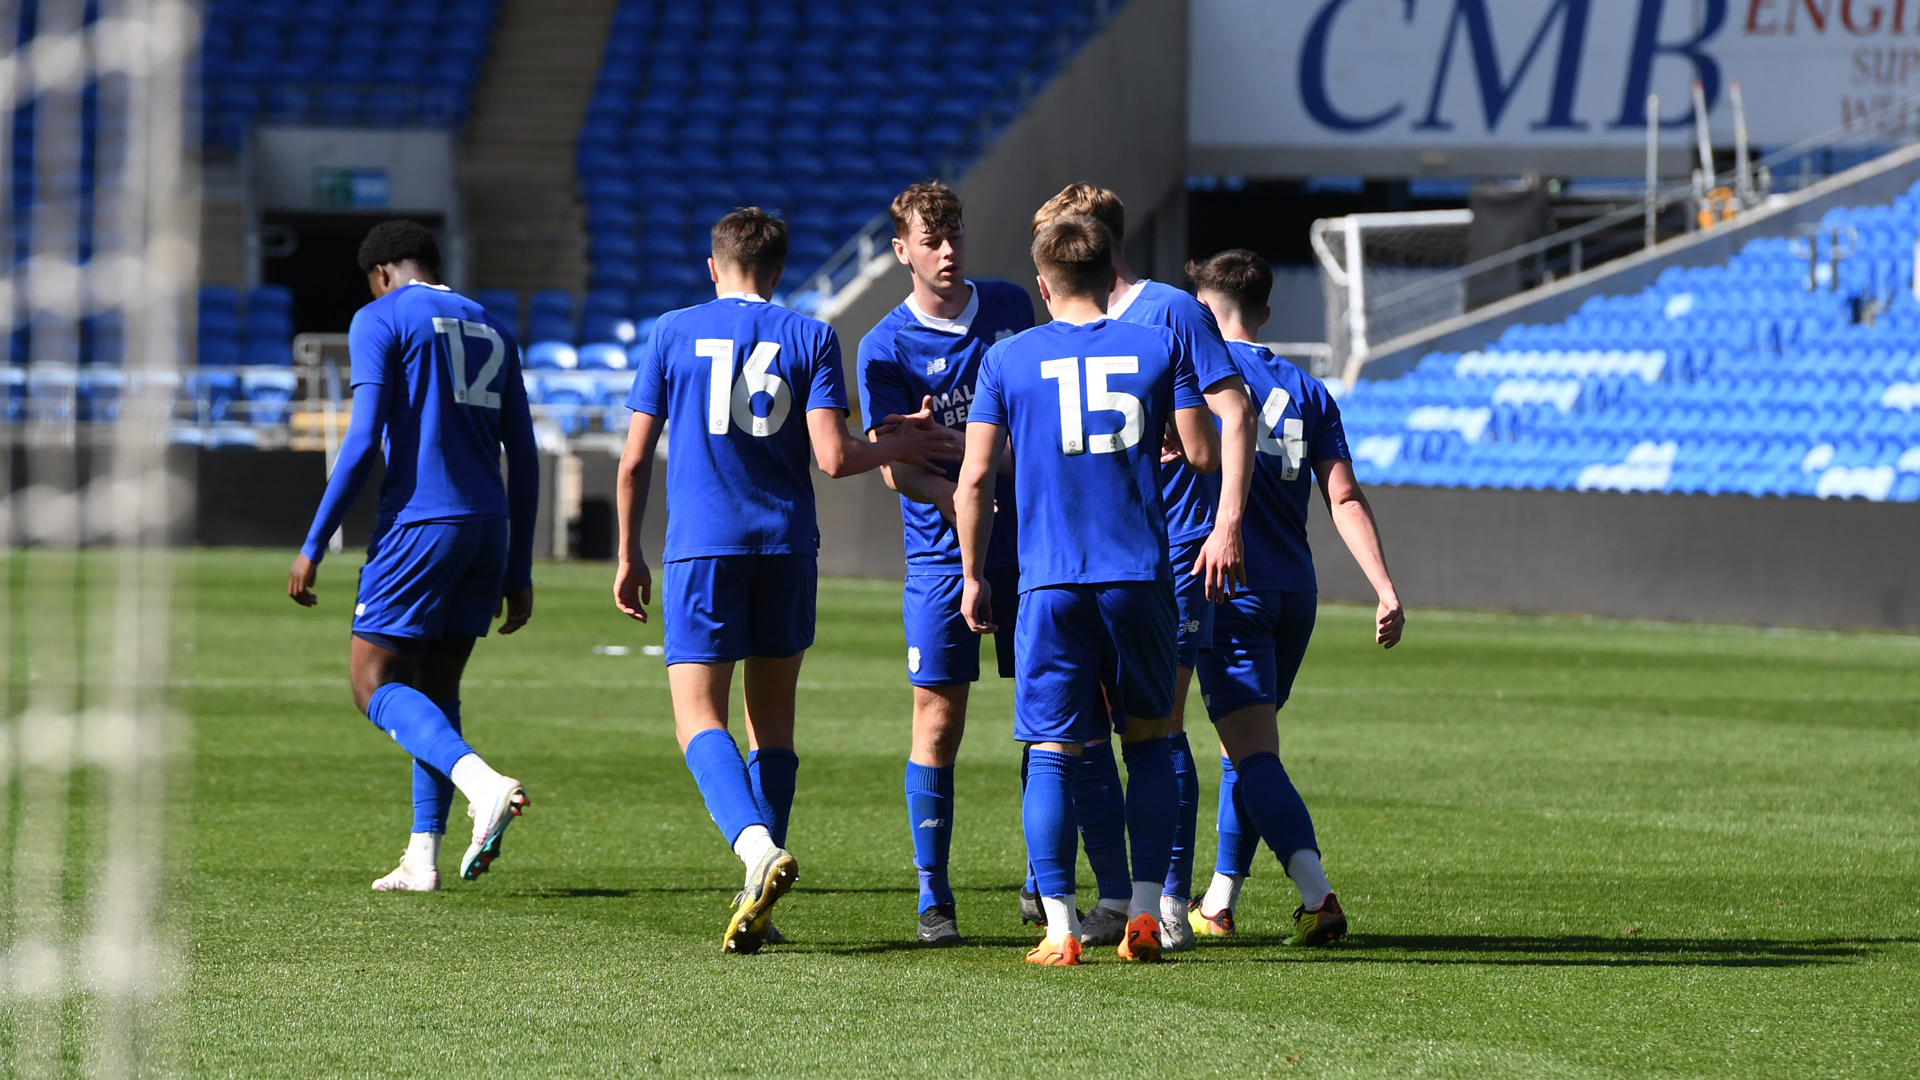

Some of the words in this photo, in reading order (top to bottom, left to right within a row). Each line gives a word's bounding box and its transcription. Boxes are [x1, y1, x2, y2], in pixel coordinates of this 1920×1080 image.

[1743, 0, 1920, 37] ENGI
[1298, 0, 1727, 135] CMB
[431, 316, 505, 409] 12
[695, 338, 792, 437] 16
[932, 384, 975, 412] MAL
[1040, 355, 1145, 455] 15
[1244, 384, 1308, 481] 4
